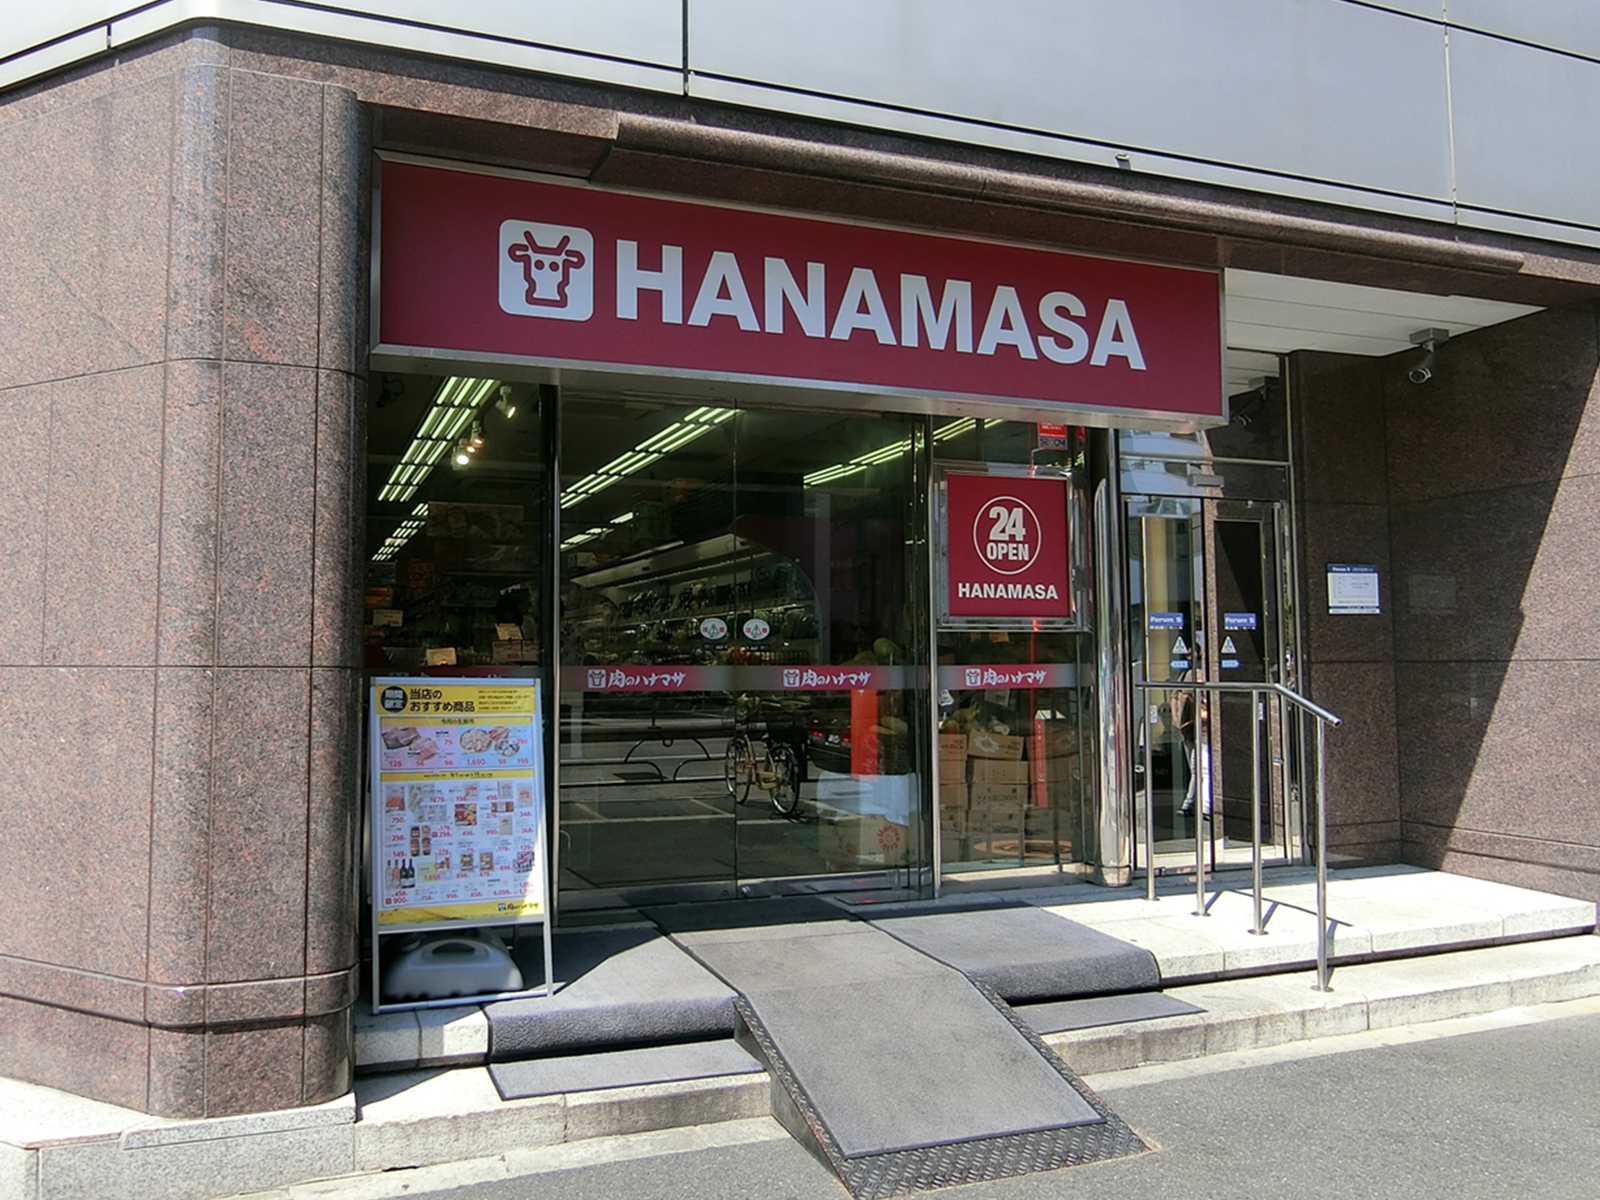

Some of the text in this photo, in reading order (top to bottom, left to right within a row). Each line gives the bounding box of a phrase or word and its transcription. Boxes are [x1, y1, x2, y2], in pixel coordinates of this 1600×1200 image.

[615, 238, 1147, 371] HANAMASA
[988, 506, 1026, 541] 24
[986, 542, 1030, 561] OPEN
[957, 582, 1058, 600] HANAMASA
[1225, 616, 1248, 624] Forum
[607, 668, 686, 688] 肉のハナマサ
[801, 668, 871, 687] 肉のハナマサ
[982, 667, 1047, 686] 肉のハナマサ
[410, 688, 443, 700] 当店の
[410, 701, 475, 712] おすすめ商品
